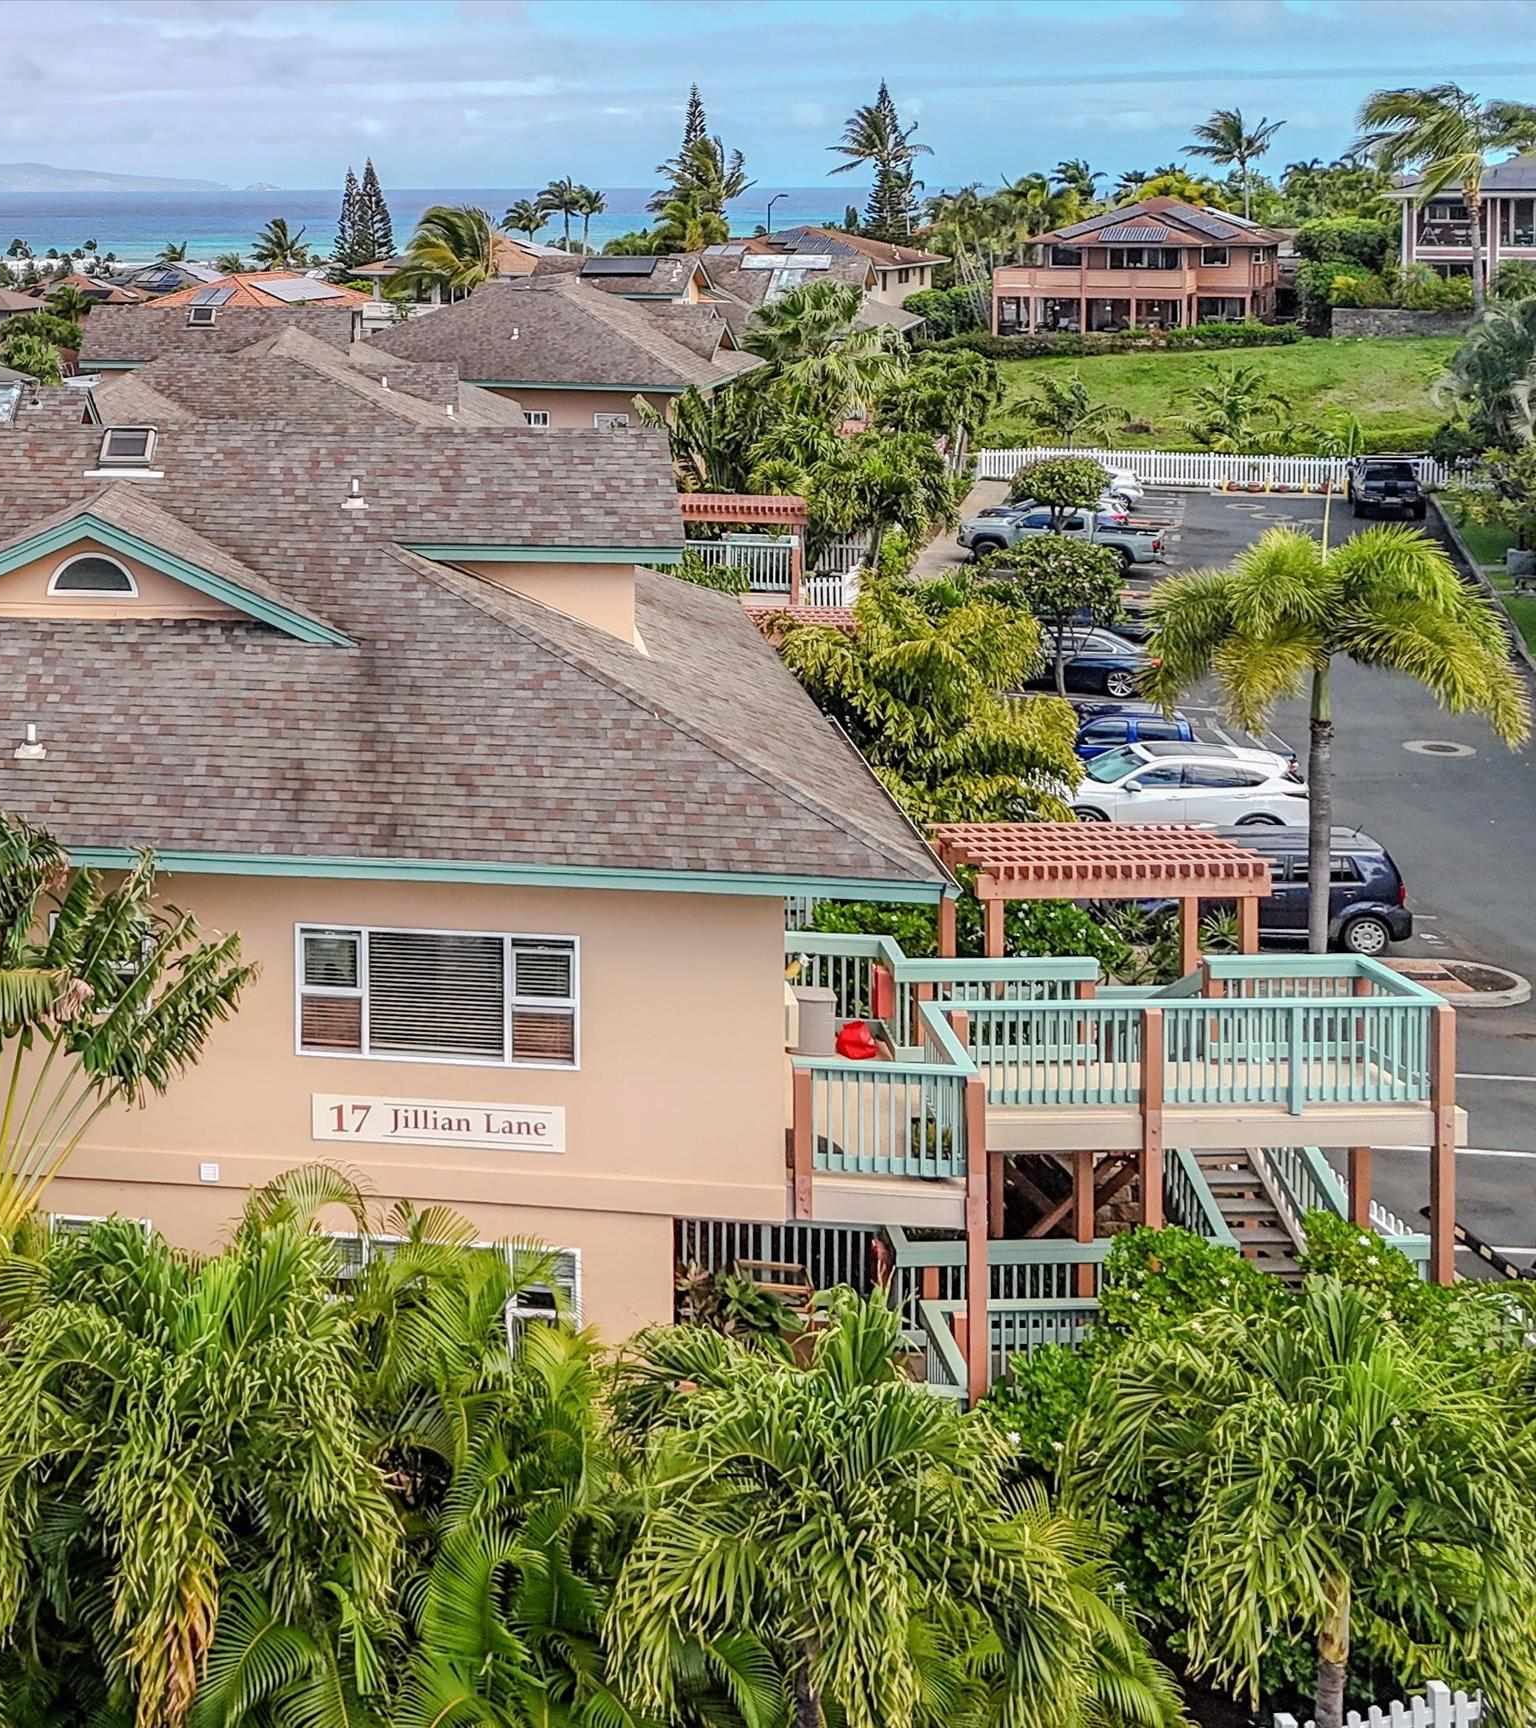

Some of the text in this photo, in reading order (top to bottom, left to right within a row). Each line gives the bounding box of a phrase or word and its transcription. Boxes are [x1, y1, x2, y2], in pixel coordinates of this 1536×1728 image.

[329, 1104, 547, 1137] 17 Jillian Lane
